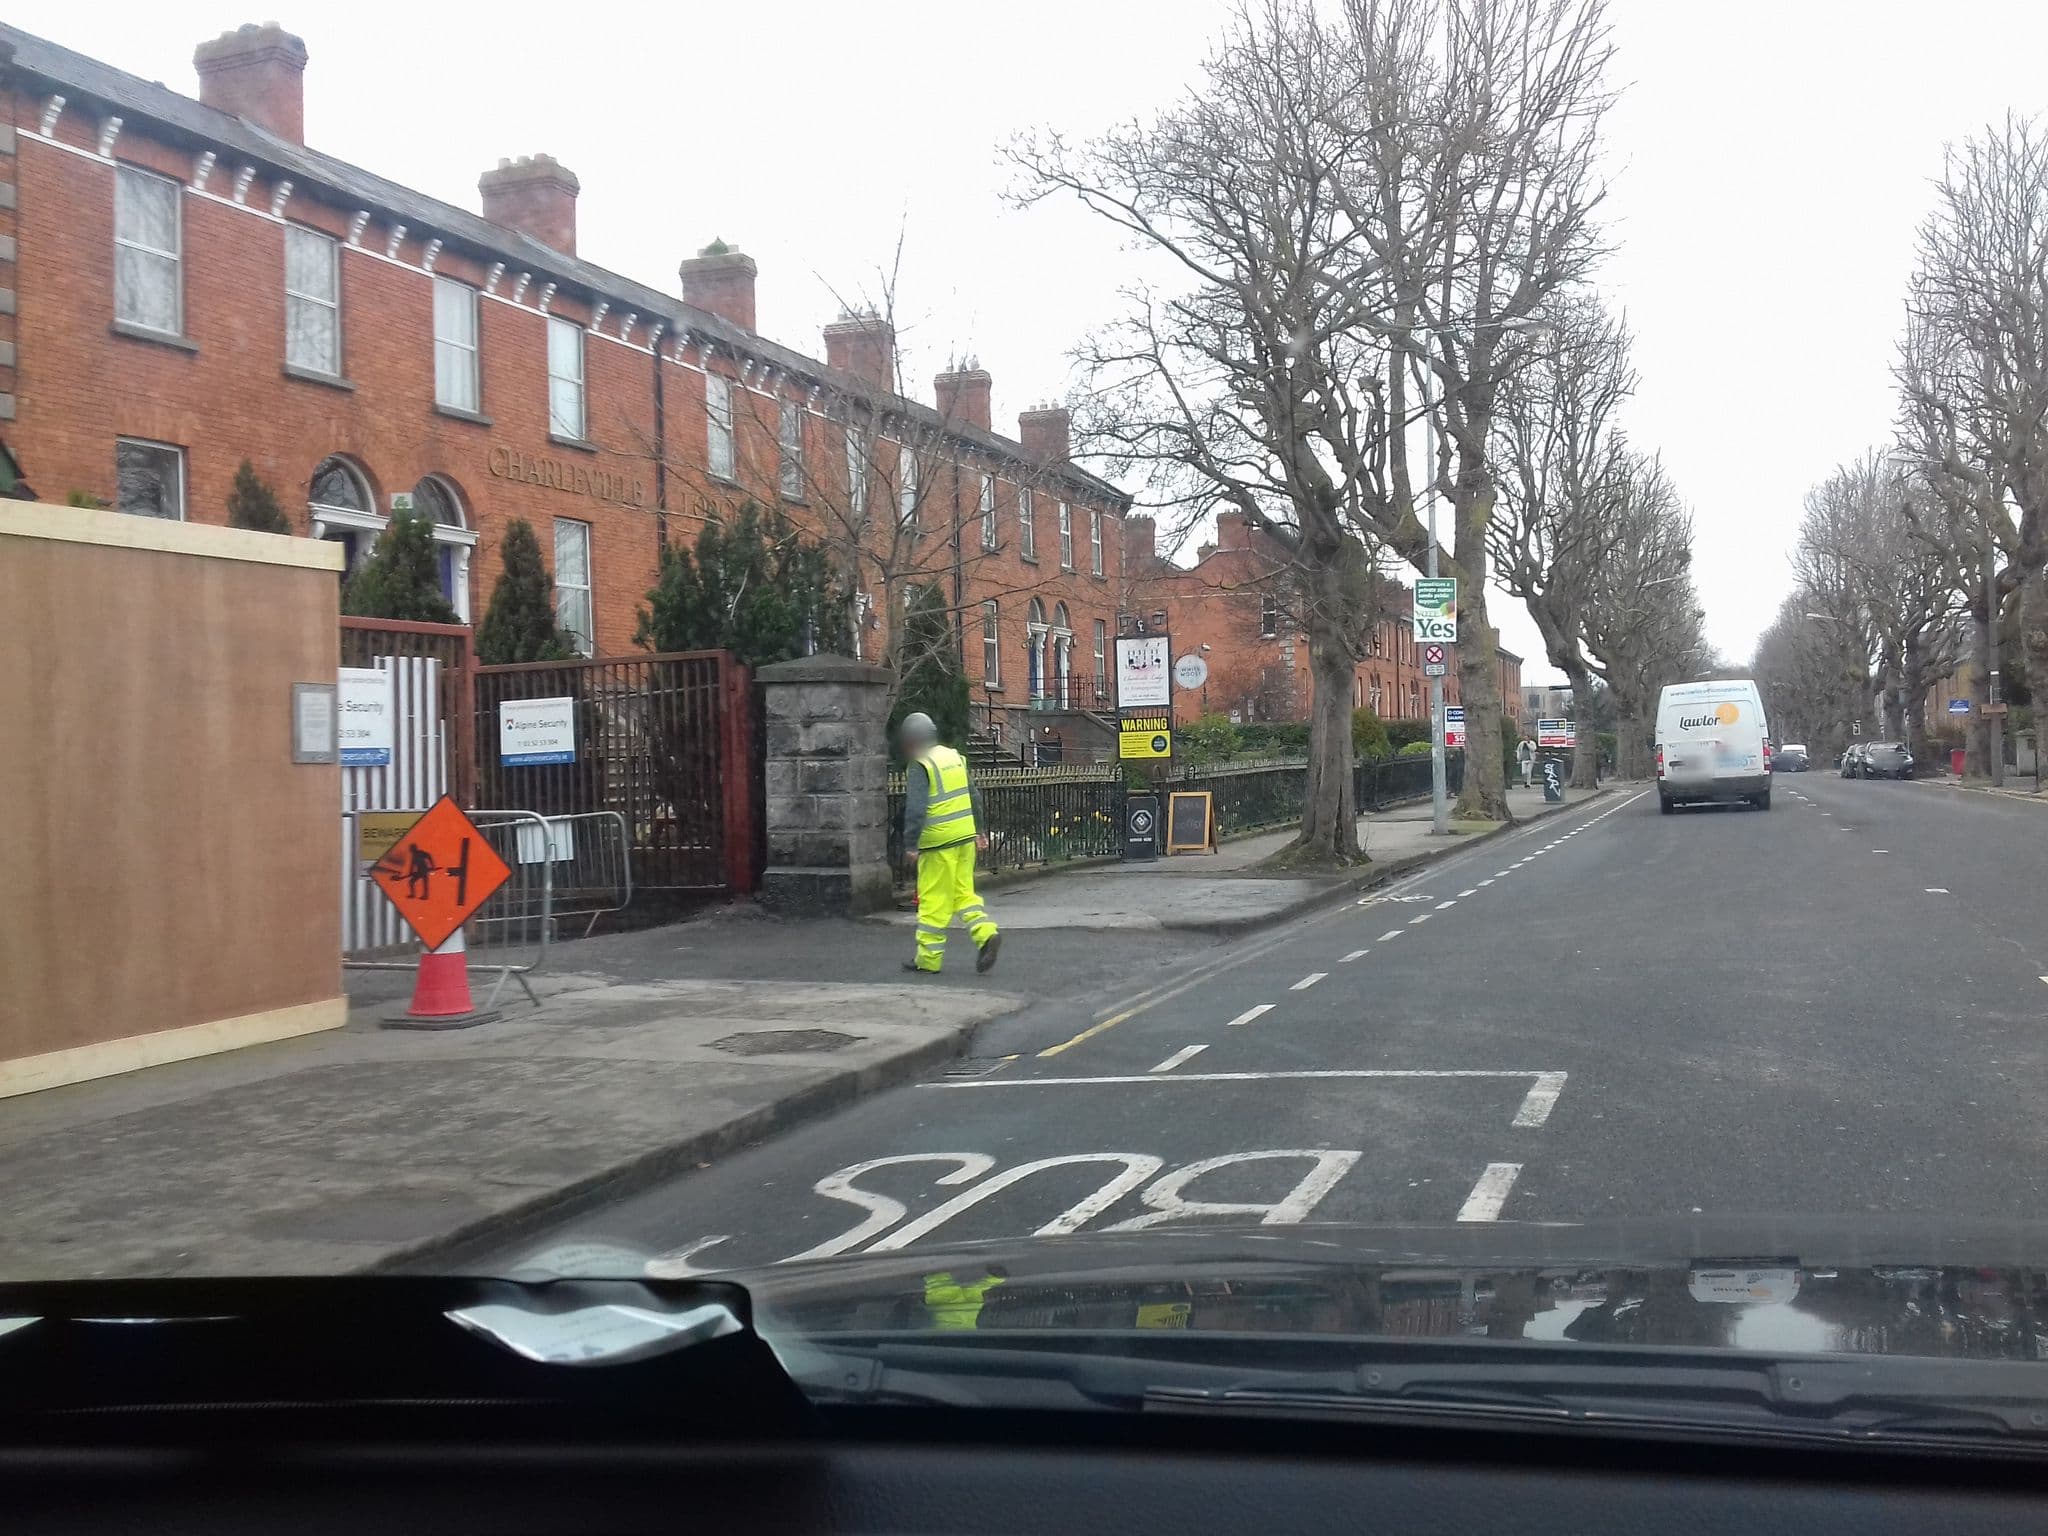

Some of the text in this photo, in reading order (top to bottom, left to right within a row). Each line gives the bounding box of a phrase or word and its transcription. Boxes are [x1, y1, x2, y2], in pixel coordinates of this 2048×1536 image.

[487, 445, 645, 508] CHARLEVILLE
[1415, 618, 1455, 638] Yes
[346, 700, 384, 715] Security
[515, 719, 568, 730] Alpine Security
[1121, 717, 1168, 732] WARNING
[1679, 715, 1721, 731] Lawlor
